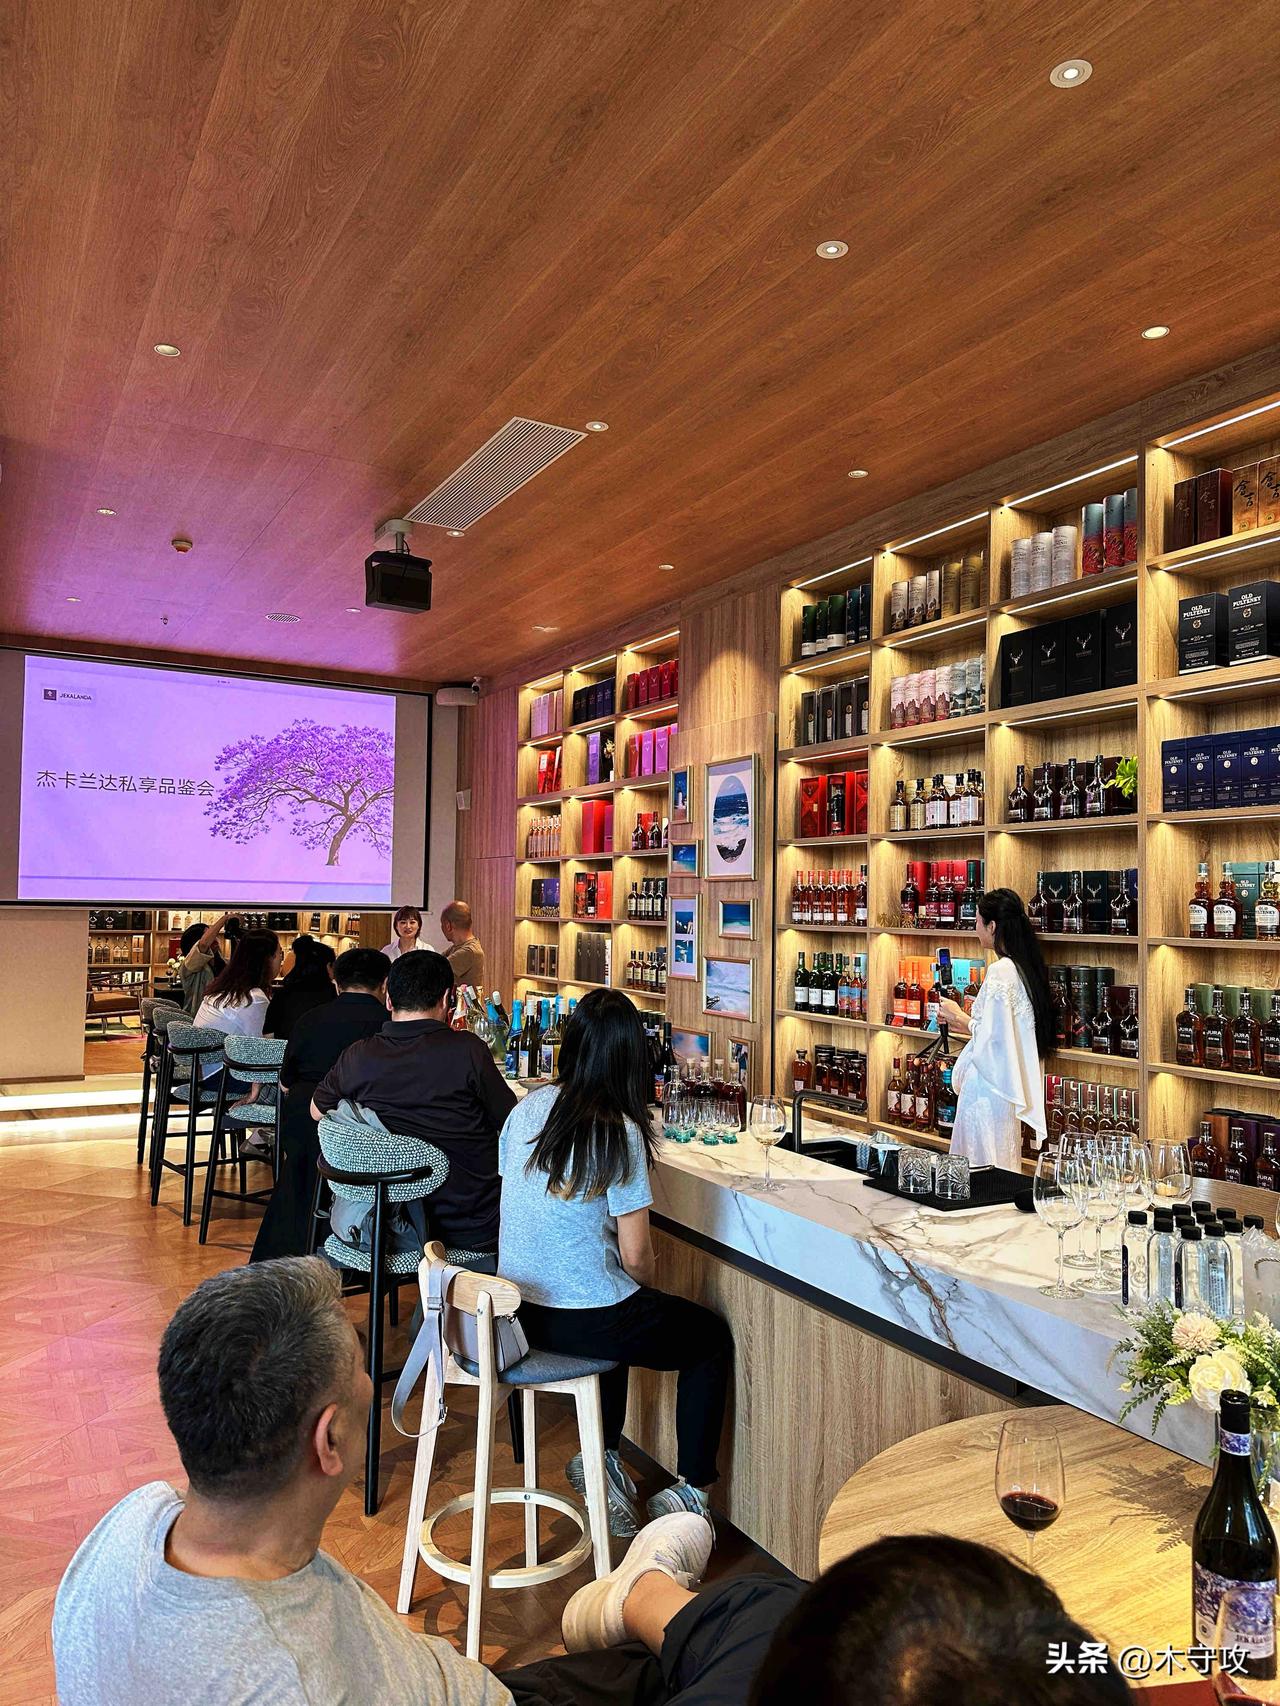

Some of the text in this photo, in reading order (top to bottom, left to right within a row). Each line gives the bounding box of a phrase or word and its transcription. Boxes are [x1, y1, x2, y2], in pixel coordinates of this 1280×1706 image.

[36, 769, 215, 797] 杰卡兰达私享品鉴会
[1194, 1160, 1209, 1168] JURA
[1225, 1167, 1240, 1175] JURA
[1257, 1174, 1273, 1182] JURA
